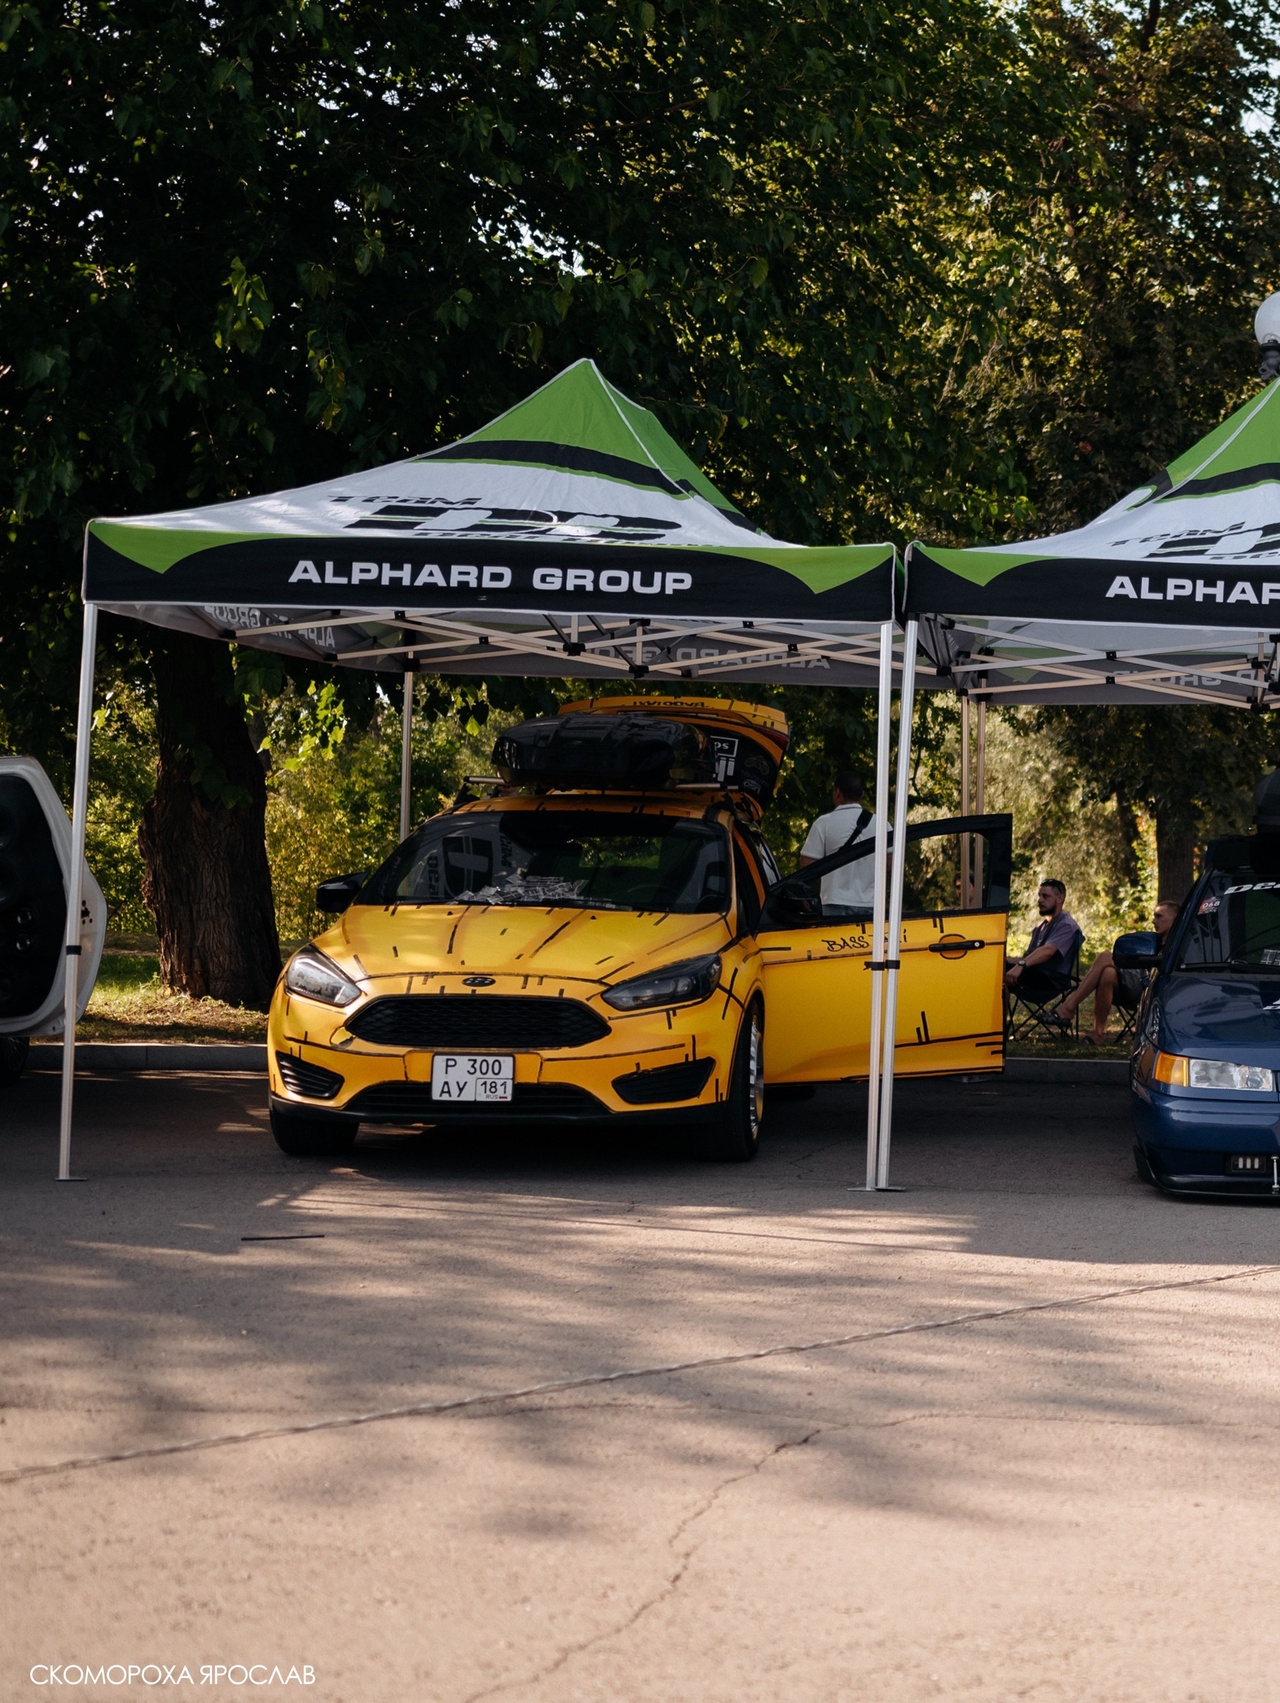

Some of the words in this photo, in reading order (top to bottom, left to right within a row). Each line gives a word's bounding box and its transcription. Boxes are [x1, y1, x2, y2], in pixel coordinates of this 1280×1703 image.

[288, 560, 512, 589] ALPHARD
[532, 567, 692, 594] GROUP
[821, 935, 870, 952] BASS
[445, 1058, 457, 1075] Р
[467, 1058, 502, 1076] 300
[439, 1081, 468, 1098] АУ
[480, 1081, 507, 1095] 181
